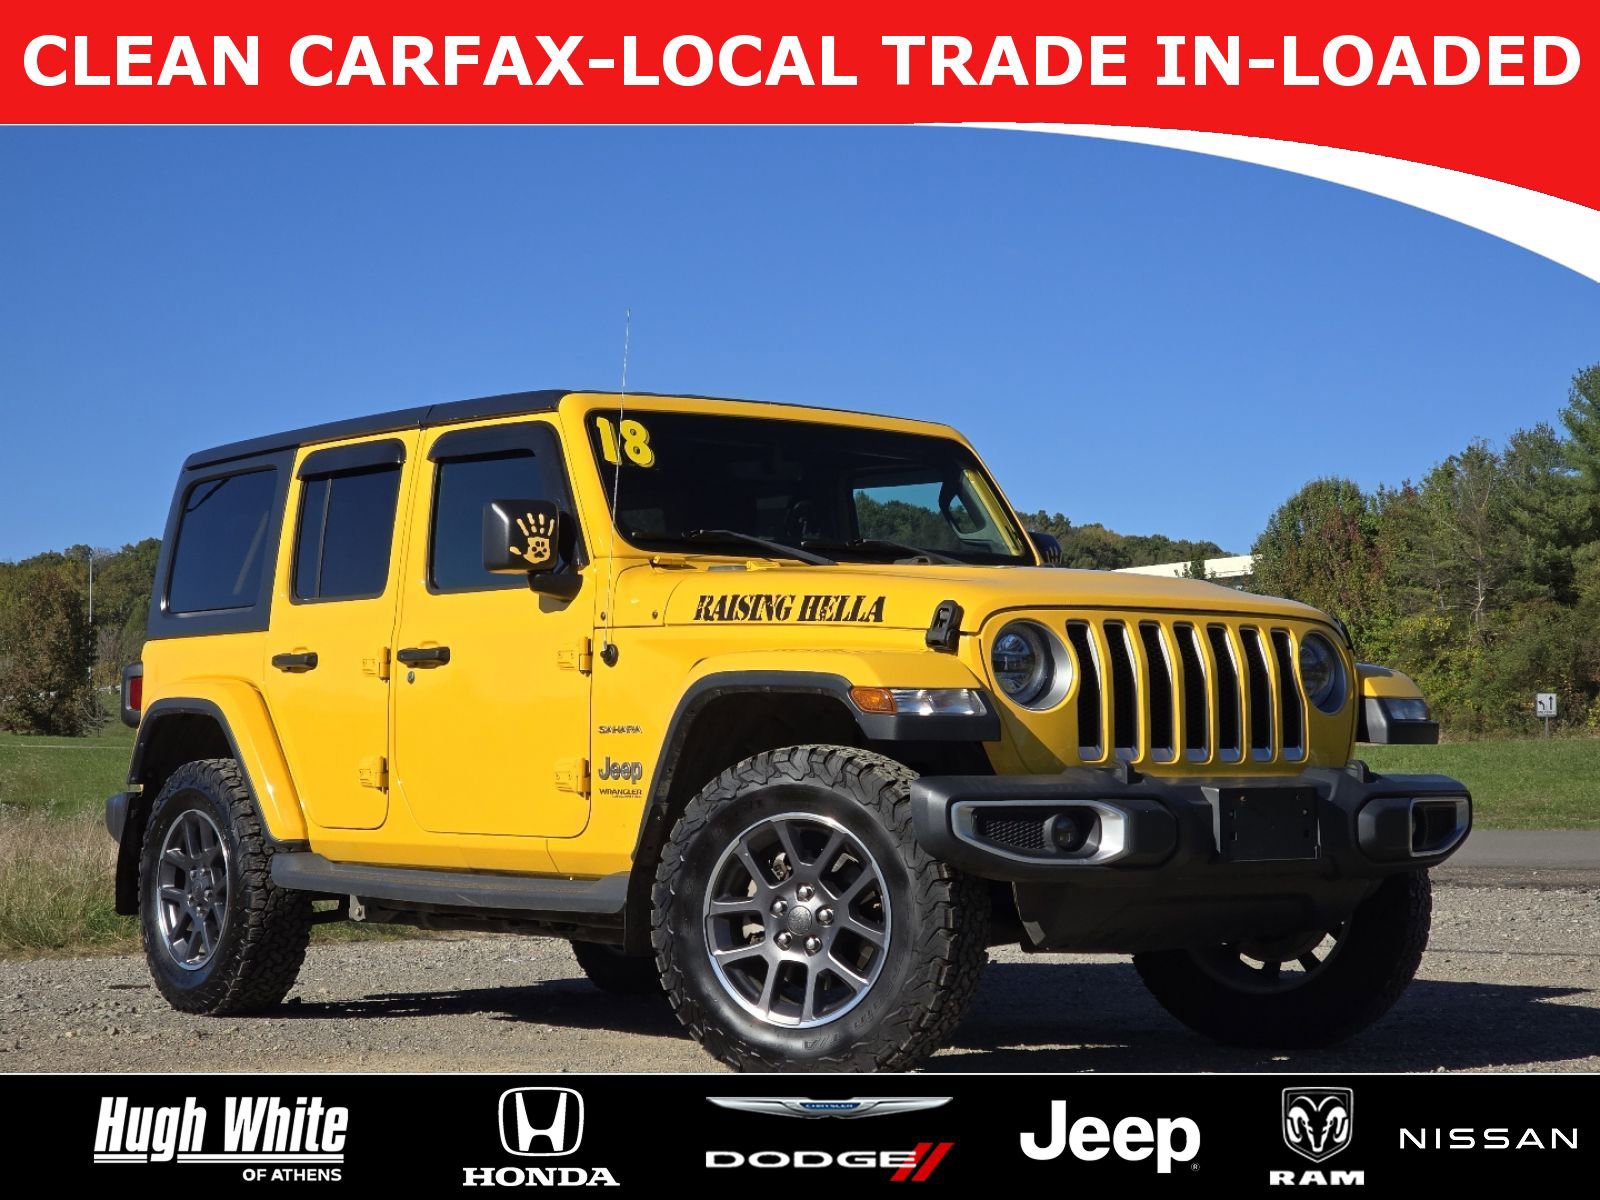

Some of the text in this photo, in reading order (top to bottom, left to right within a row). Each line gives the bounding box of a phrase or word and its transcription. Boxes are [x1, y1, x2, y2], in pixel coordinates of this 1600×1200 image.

[596, 416, 655, 468] 18
[693, 594, 886, 622] RAISING HELLA
[598, 725, 643, 734] SAHARA
[598, 756, 643, 785] Jeep
[599, 788, 642, 796] WRANGLER
